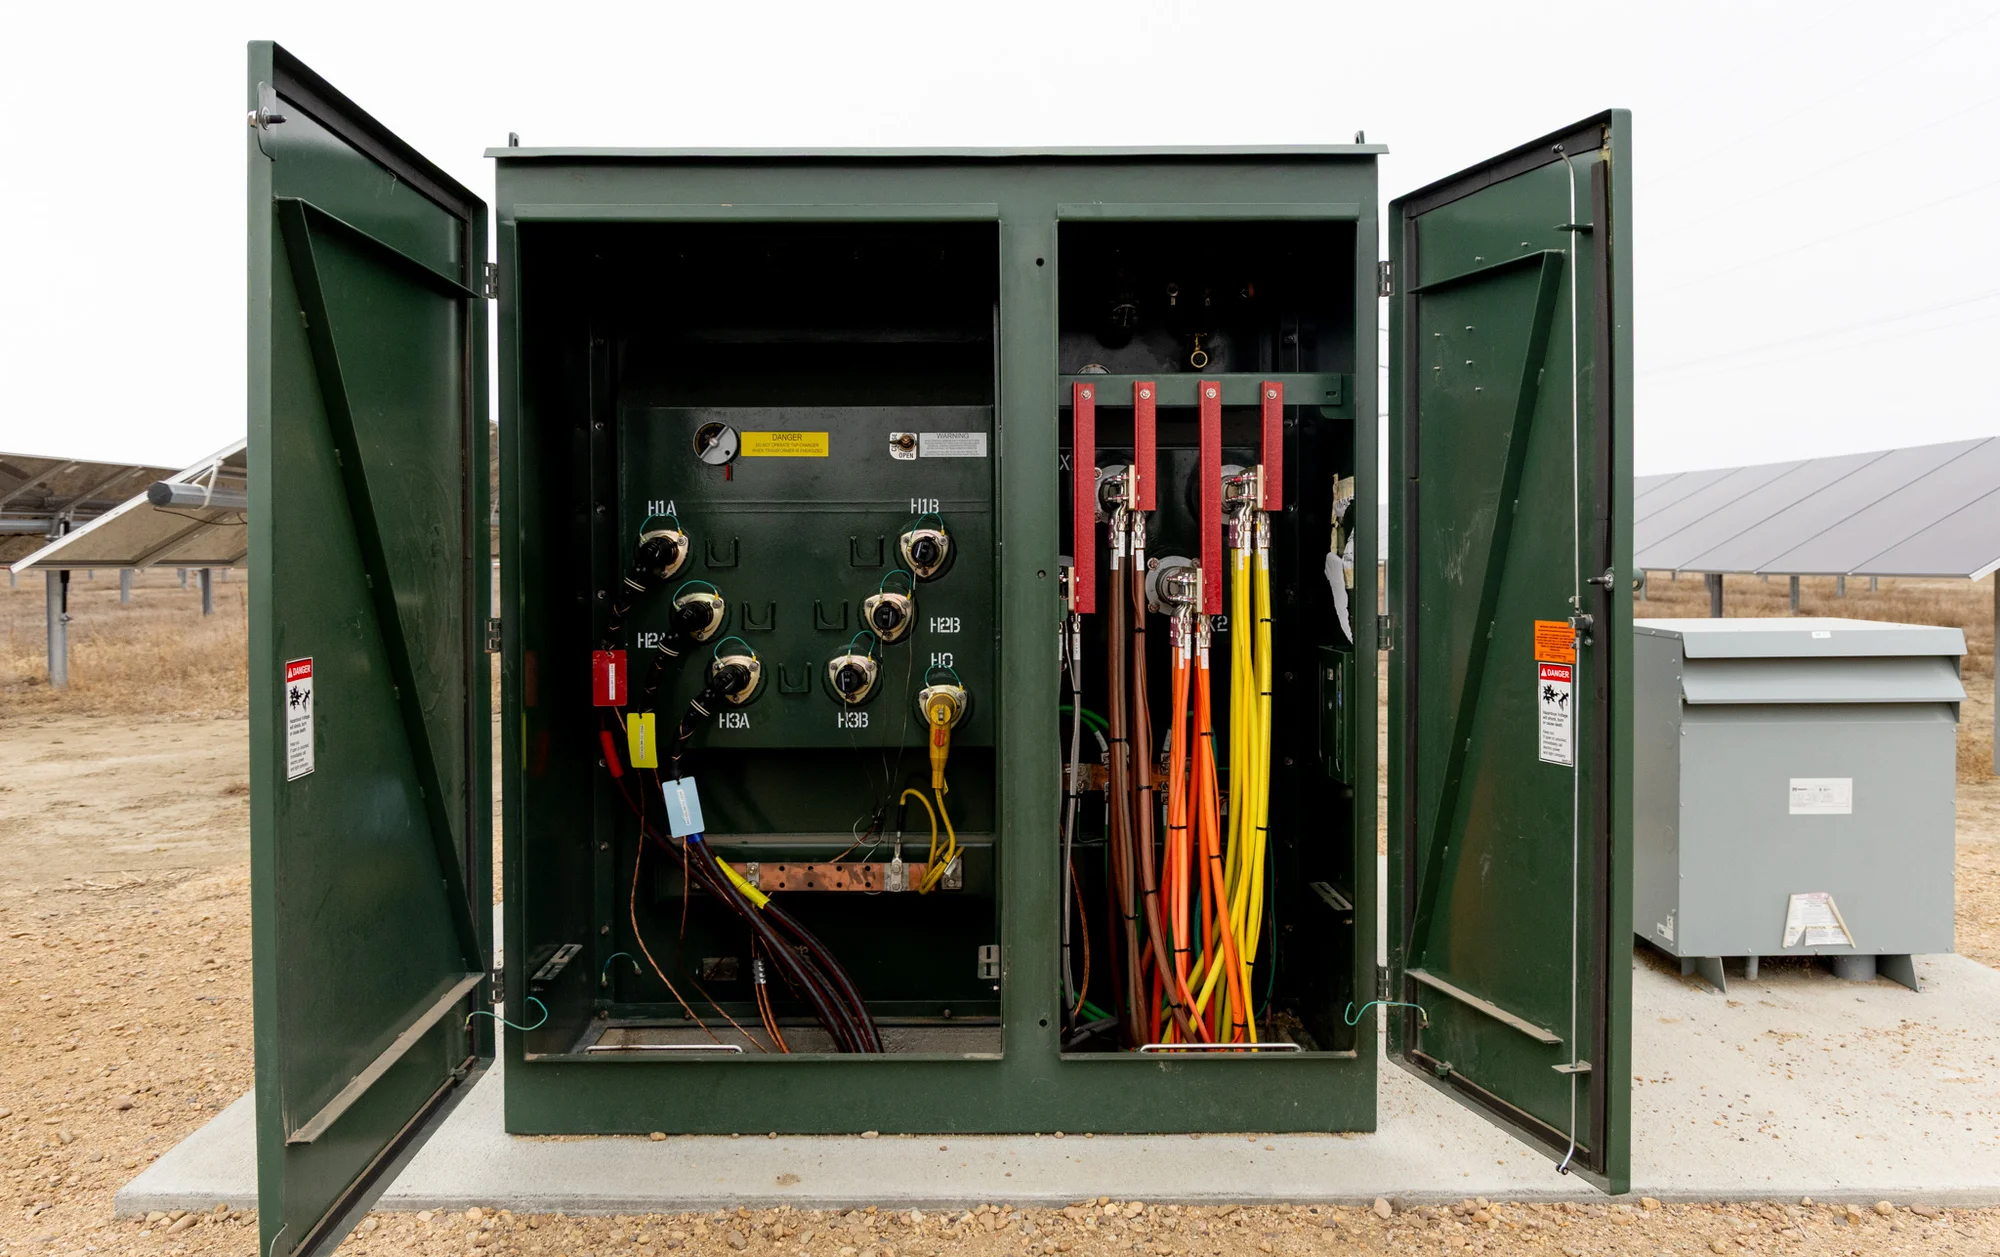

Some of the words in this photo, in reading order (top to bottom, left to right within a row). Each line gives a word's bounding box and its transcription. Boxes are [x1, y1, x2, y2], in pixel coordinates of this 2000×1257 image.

[772, 433, 803, 441] DANGER
[648, 500, 677, 517] H1A
[910, 497, 940, 515] H1B
[930, 617, 961, 633] H2B
[292, 665, 311, 676] DANGER
[1547, 668, 1570, 679] DANGER
[718, 712, 751, 729] H3A
[837, 711, 869, 729] H3B
